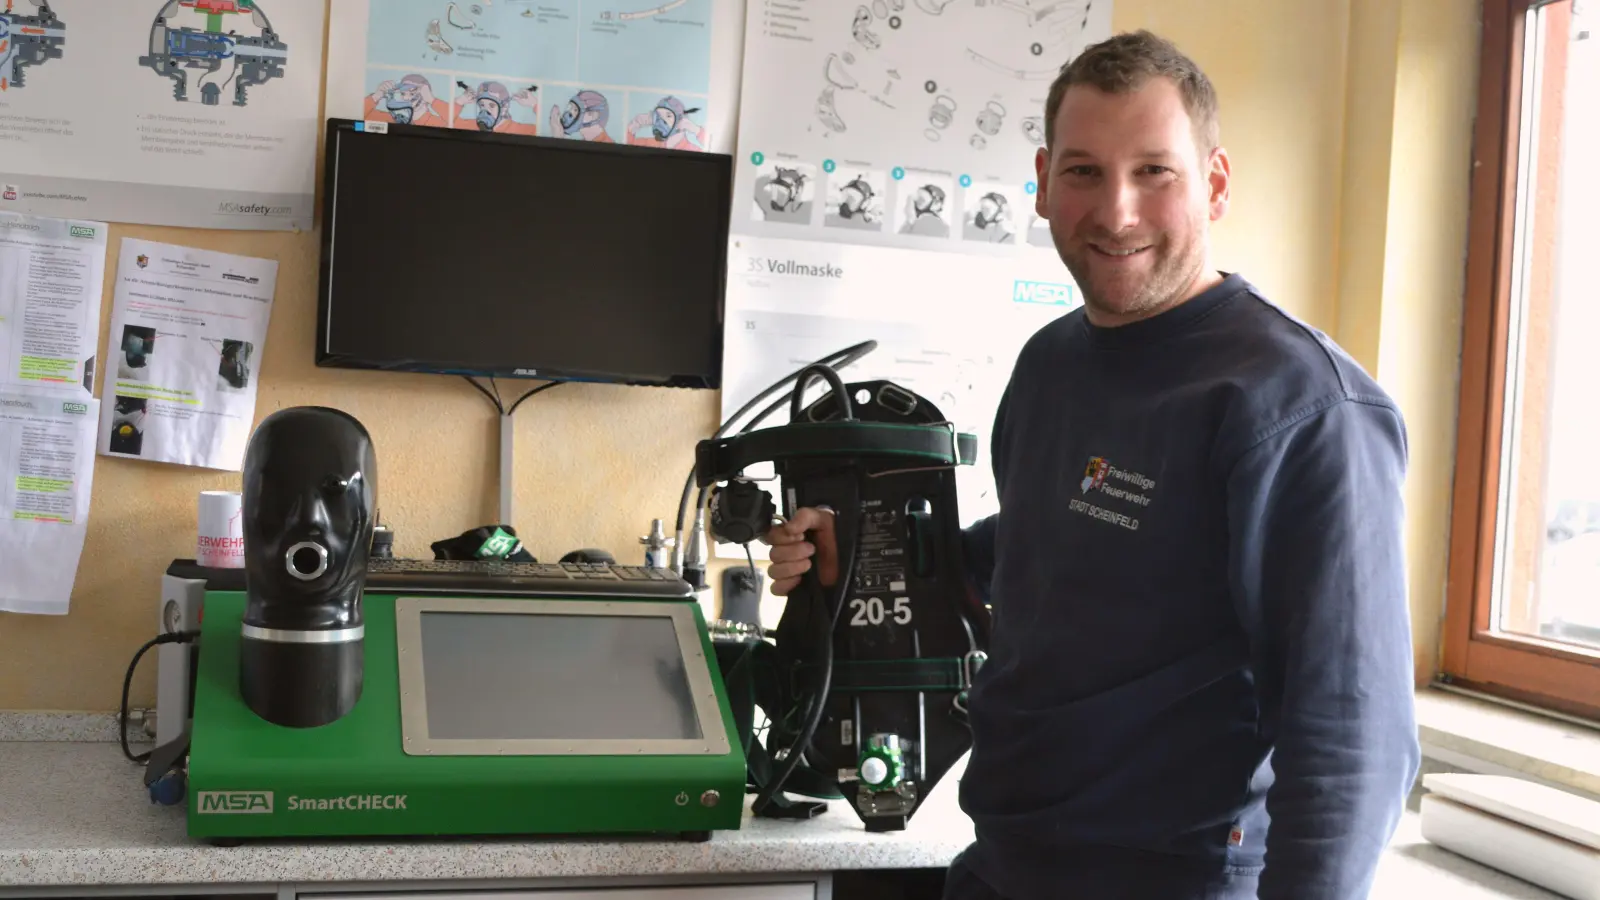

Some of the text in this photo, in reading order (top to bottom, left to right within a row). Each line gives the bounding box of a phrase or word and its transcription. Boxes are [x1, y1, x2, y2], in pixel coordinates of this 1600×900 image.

[218, 202, 292, 216] MSAsafety.com
[71, 226, 94, 237] MSA
[747, 257, 843, 278] 3S Vollmaske
[1014, 281, 1072, 305] MSA
[63, 403, 86, 413] MSA
[1107, 466, 1156, 489] Freiwillige
[1100, 482, 1151, 508] Feuerwehr
[1069, 499, 1139, 531] STADT SCHEINFELD
[850, 597, 912, 626] 20-5
[200, 792, 407, 812] MSA SmartCHECK
